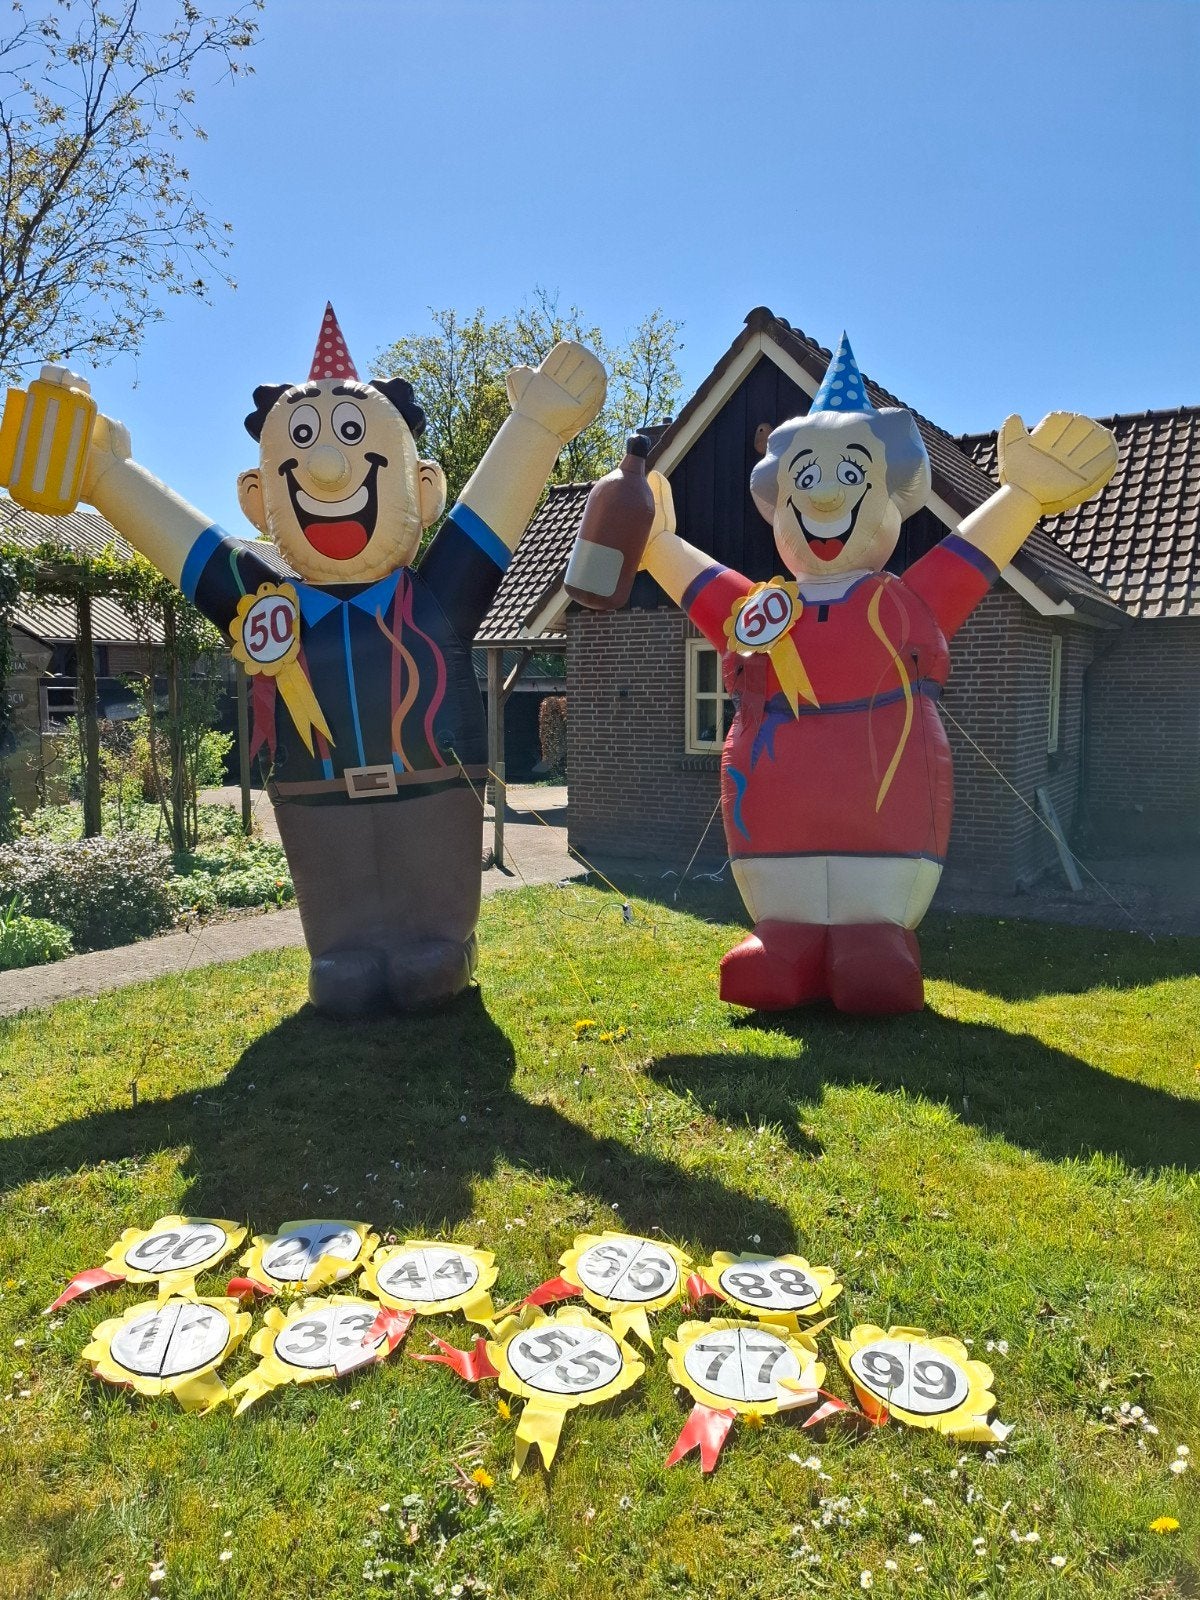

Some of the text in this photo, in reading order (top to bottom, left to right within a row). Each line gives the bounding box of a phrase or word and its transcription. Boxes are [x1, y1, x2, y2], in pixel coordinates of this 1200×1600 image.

[249, 604, 294, 652] 50
[743, 592, 789, 638] 50
[135, 1233, 217, 1260] 00
[386, 1256, 472, 1289] 44
[585, 1245, 671, 1293] 66
[728, 1268, 815, 1299] 88
[285, 1313, 377, 1354] 33
[518, 1329, 618, 1386] 55
[695, 1344, 787, 1384] 77
[861, 1350, 957, 1400] 99
